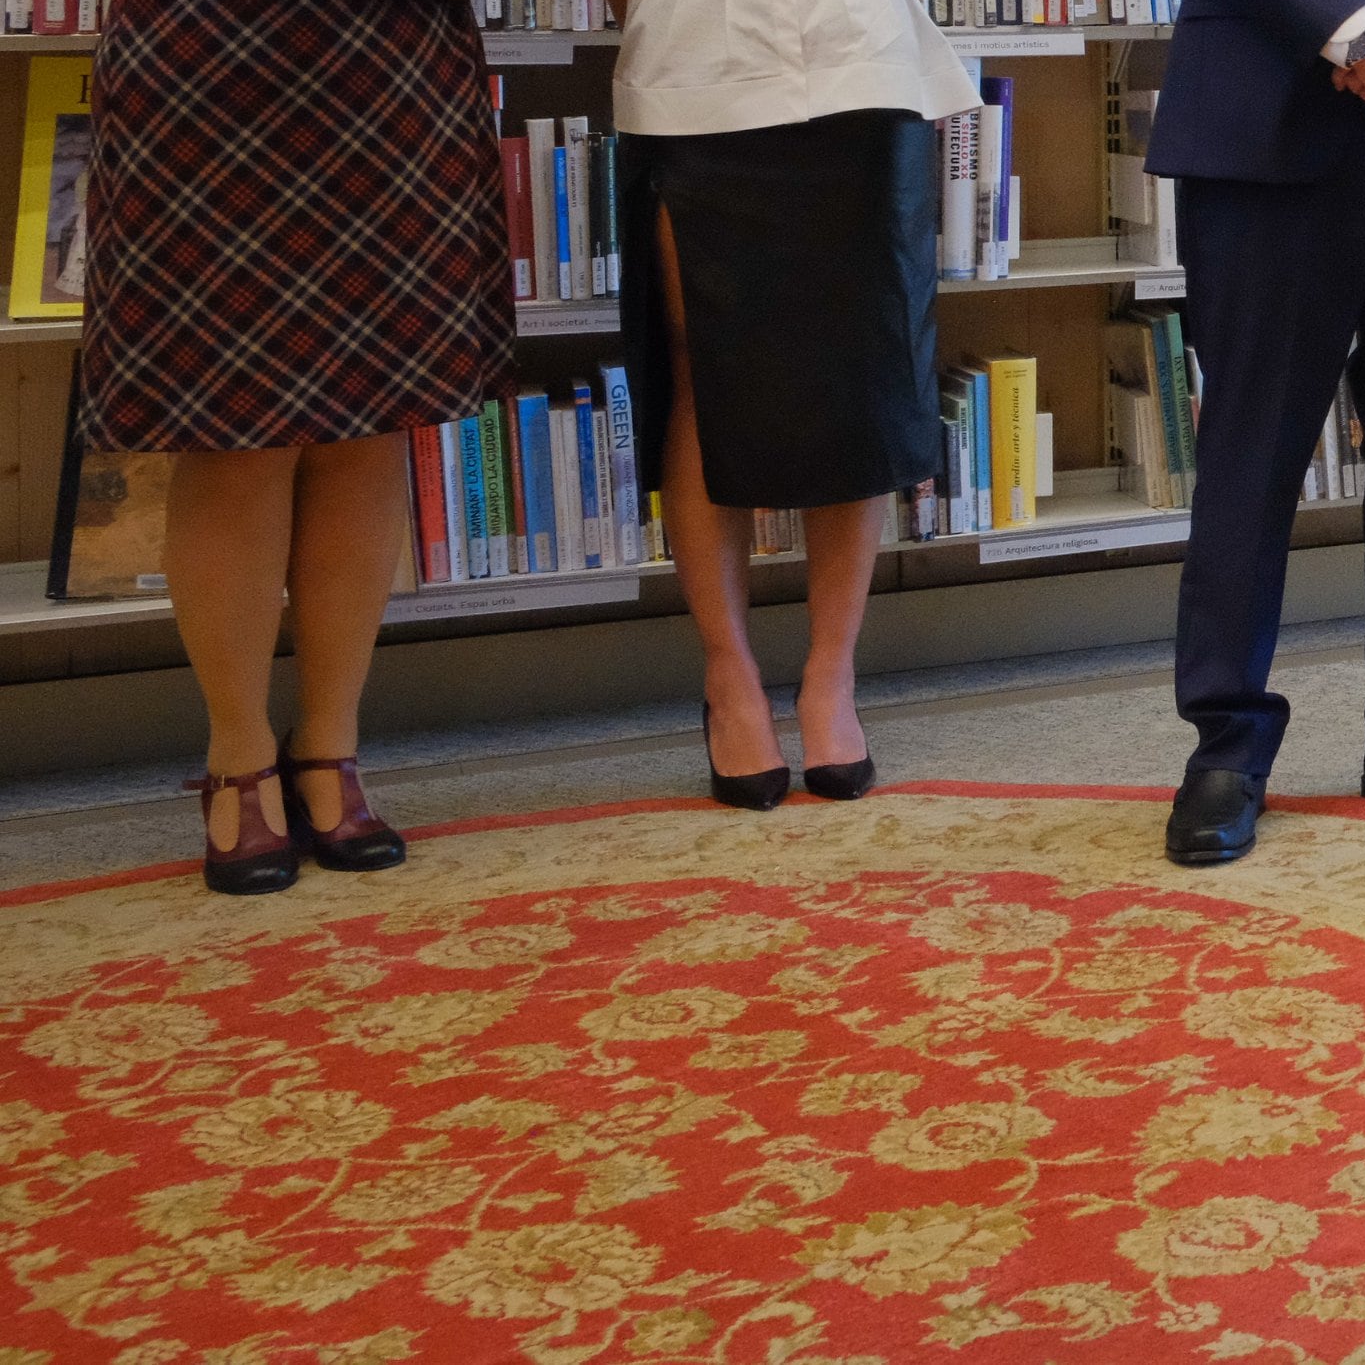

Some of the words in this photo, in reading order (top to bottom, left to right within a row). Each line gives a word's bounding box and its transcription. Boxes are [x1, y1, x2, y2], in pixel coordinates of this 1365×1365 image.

[950, 116, 961, 181] UITECTURA
[961, 122, 969, 161] SIGLO
[969, 112, 979, 181] BANISMO
[961, 164, 969, 181] XX
[549, 318, 593, 328] societat.
[611, 384, 631, 451] GREEN
[1009, 387, 1020, 423] técnica
[463, 428, 478, 467] CIUTAT
[484, 417, 499, 464] CIUDAD
[1011, 432, 1020, 454] arte
[467, 468, 479, 485] LA
[487, 464, 498, 480] LA
[468, 488, 483, 540] AMINANT
[488, 481, 503, 538] MINANDO
[1005, 543, 1061, 555] Arquitectura
[1062, 537, 1100, 550] religiosa
